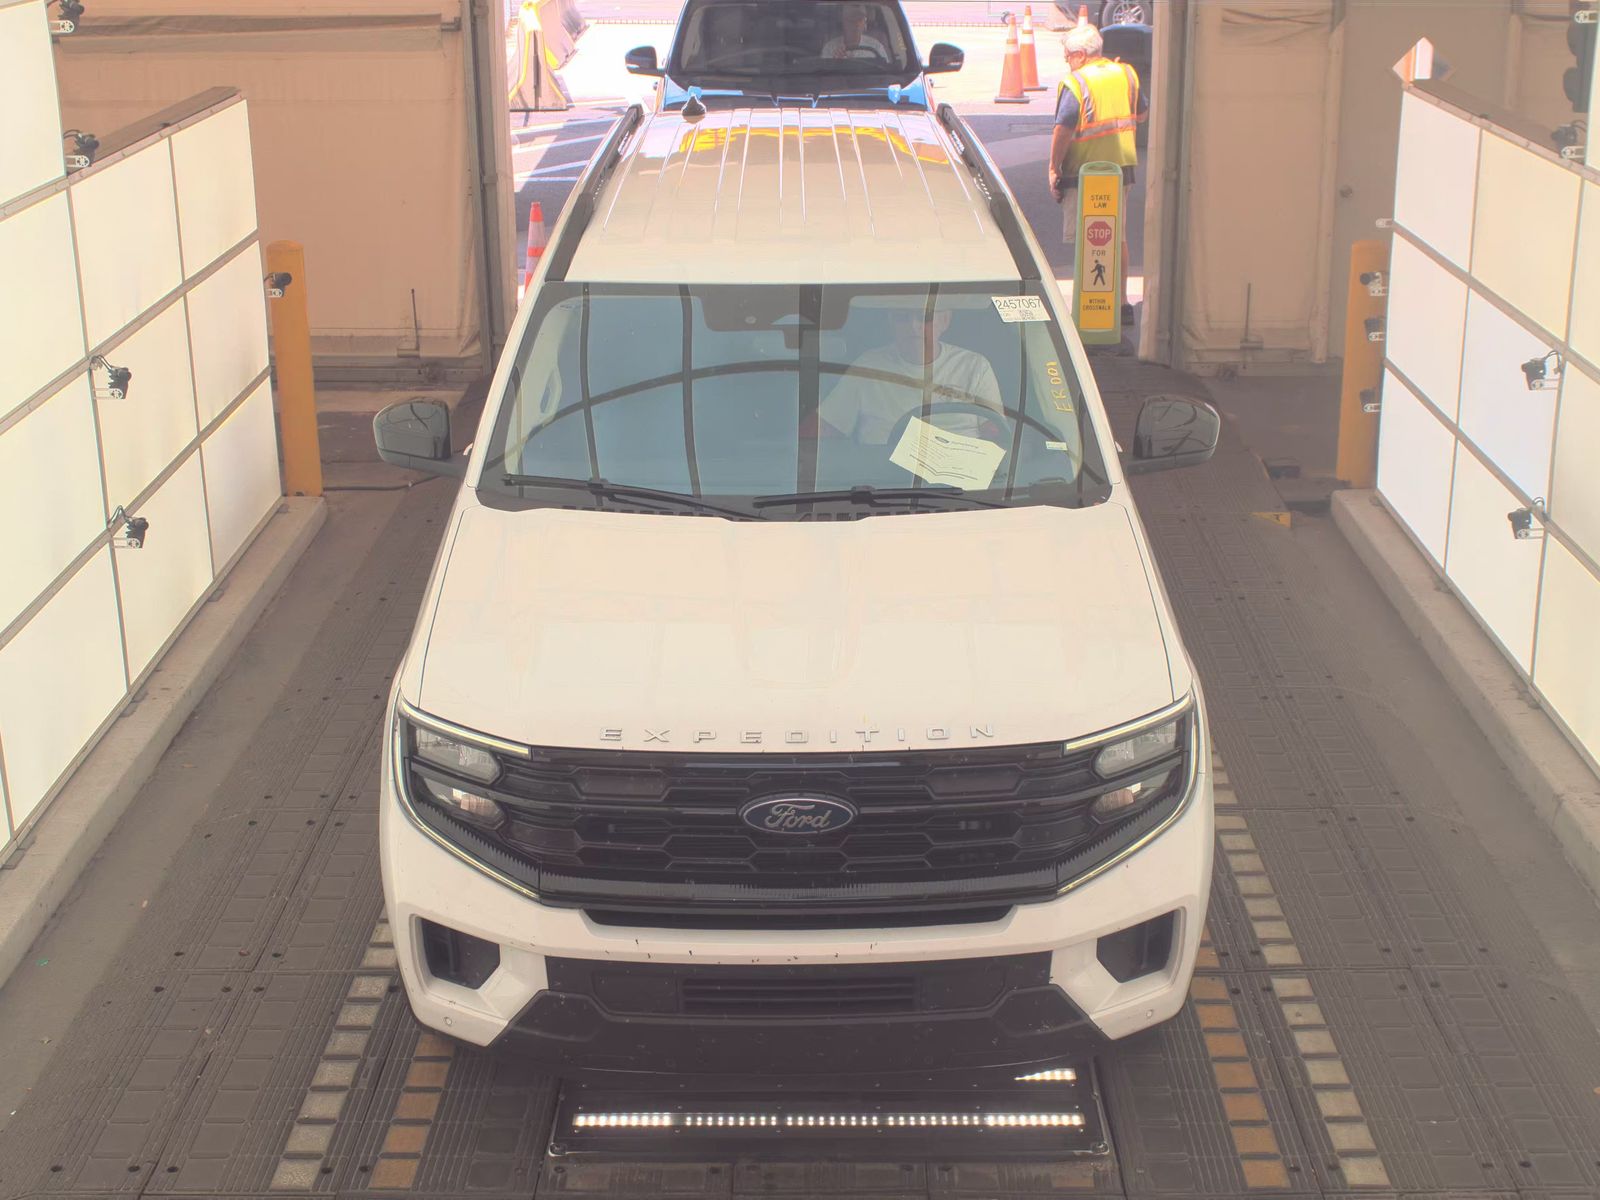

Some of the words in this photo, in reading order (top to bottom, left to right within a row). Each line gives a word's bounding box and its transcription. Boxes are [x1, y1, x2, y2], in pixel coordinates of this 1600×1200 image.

[1087, 227, 1112, 240] STOP
[995, 298, 1041, 310] 2457067
[599, 723, 994, 744] EXPEDITION
[764, 803, 831, 830] Ford
